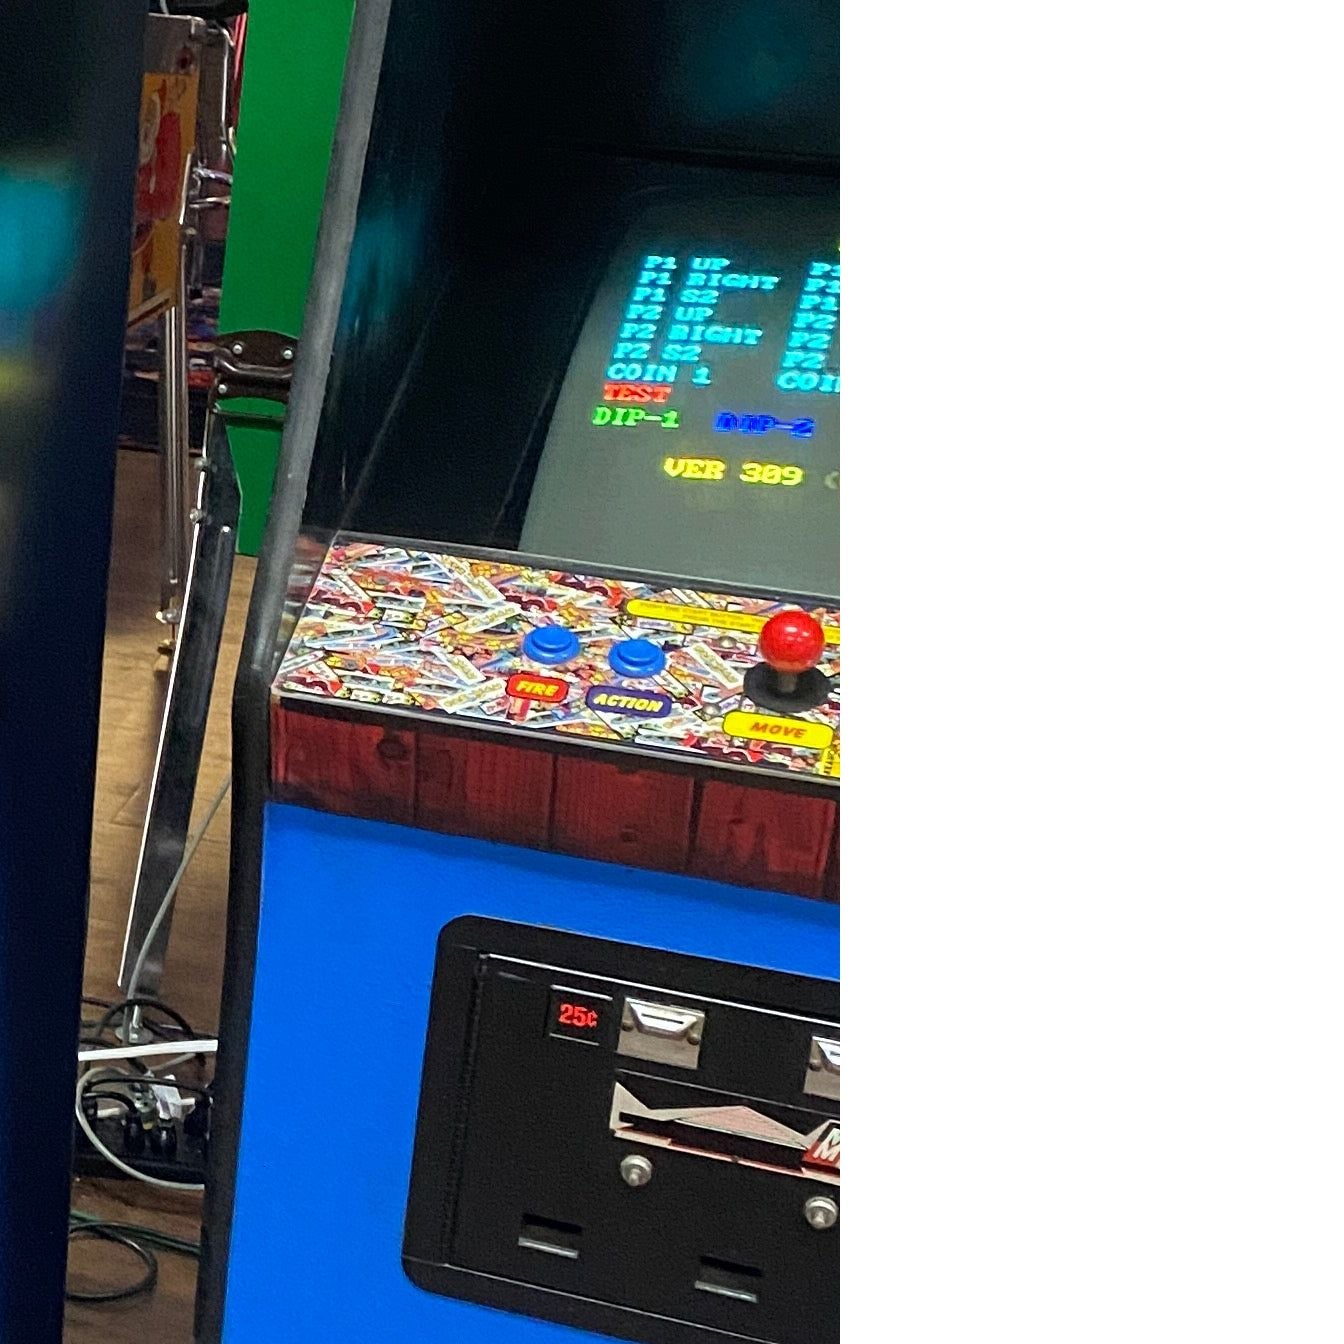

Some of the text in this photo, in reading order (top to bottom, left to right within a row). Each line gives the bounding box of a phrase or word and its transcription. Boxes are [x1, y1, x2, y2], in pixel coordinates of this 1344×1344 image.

[644, 256, 730, 271] P1 UP
[639, 271, 779, 290] P1 RIGHT
[633, 288, 719, 304] P1 S2
[626, 305, 713, 321] P2 UP
[793, 312, 837, 329] P2
[620, 323, 763, 345] P2 RIGHT
[788, 331, 831, 349] P2
[613, 343, 702, 361] P2 S2
[782, 350, 825, 369] P2
[607, 363, 711, 385] COIN 1
[604, 383, 672, 403] TEST
[592, 406, 680, 428] DIP-1
[714, 412, 815, 438] DIP-2
[663, 457, 804, 486] VER 309
[515, 680, 558, 697] FIRE
[593, 693, 663, 713] ACTION
[750, 721, 806, 739] MOVE
[558, 1002, 599, 1030] 25¢
